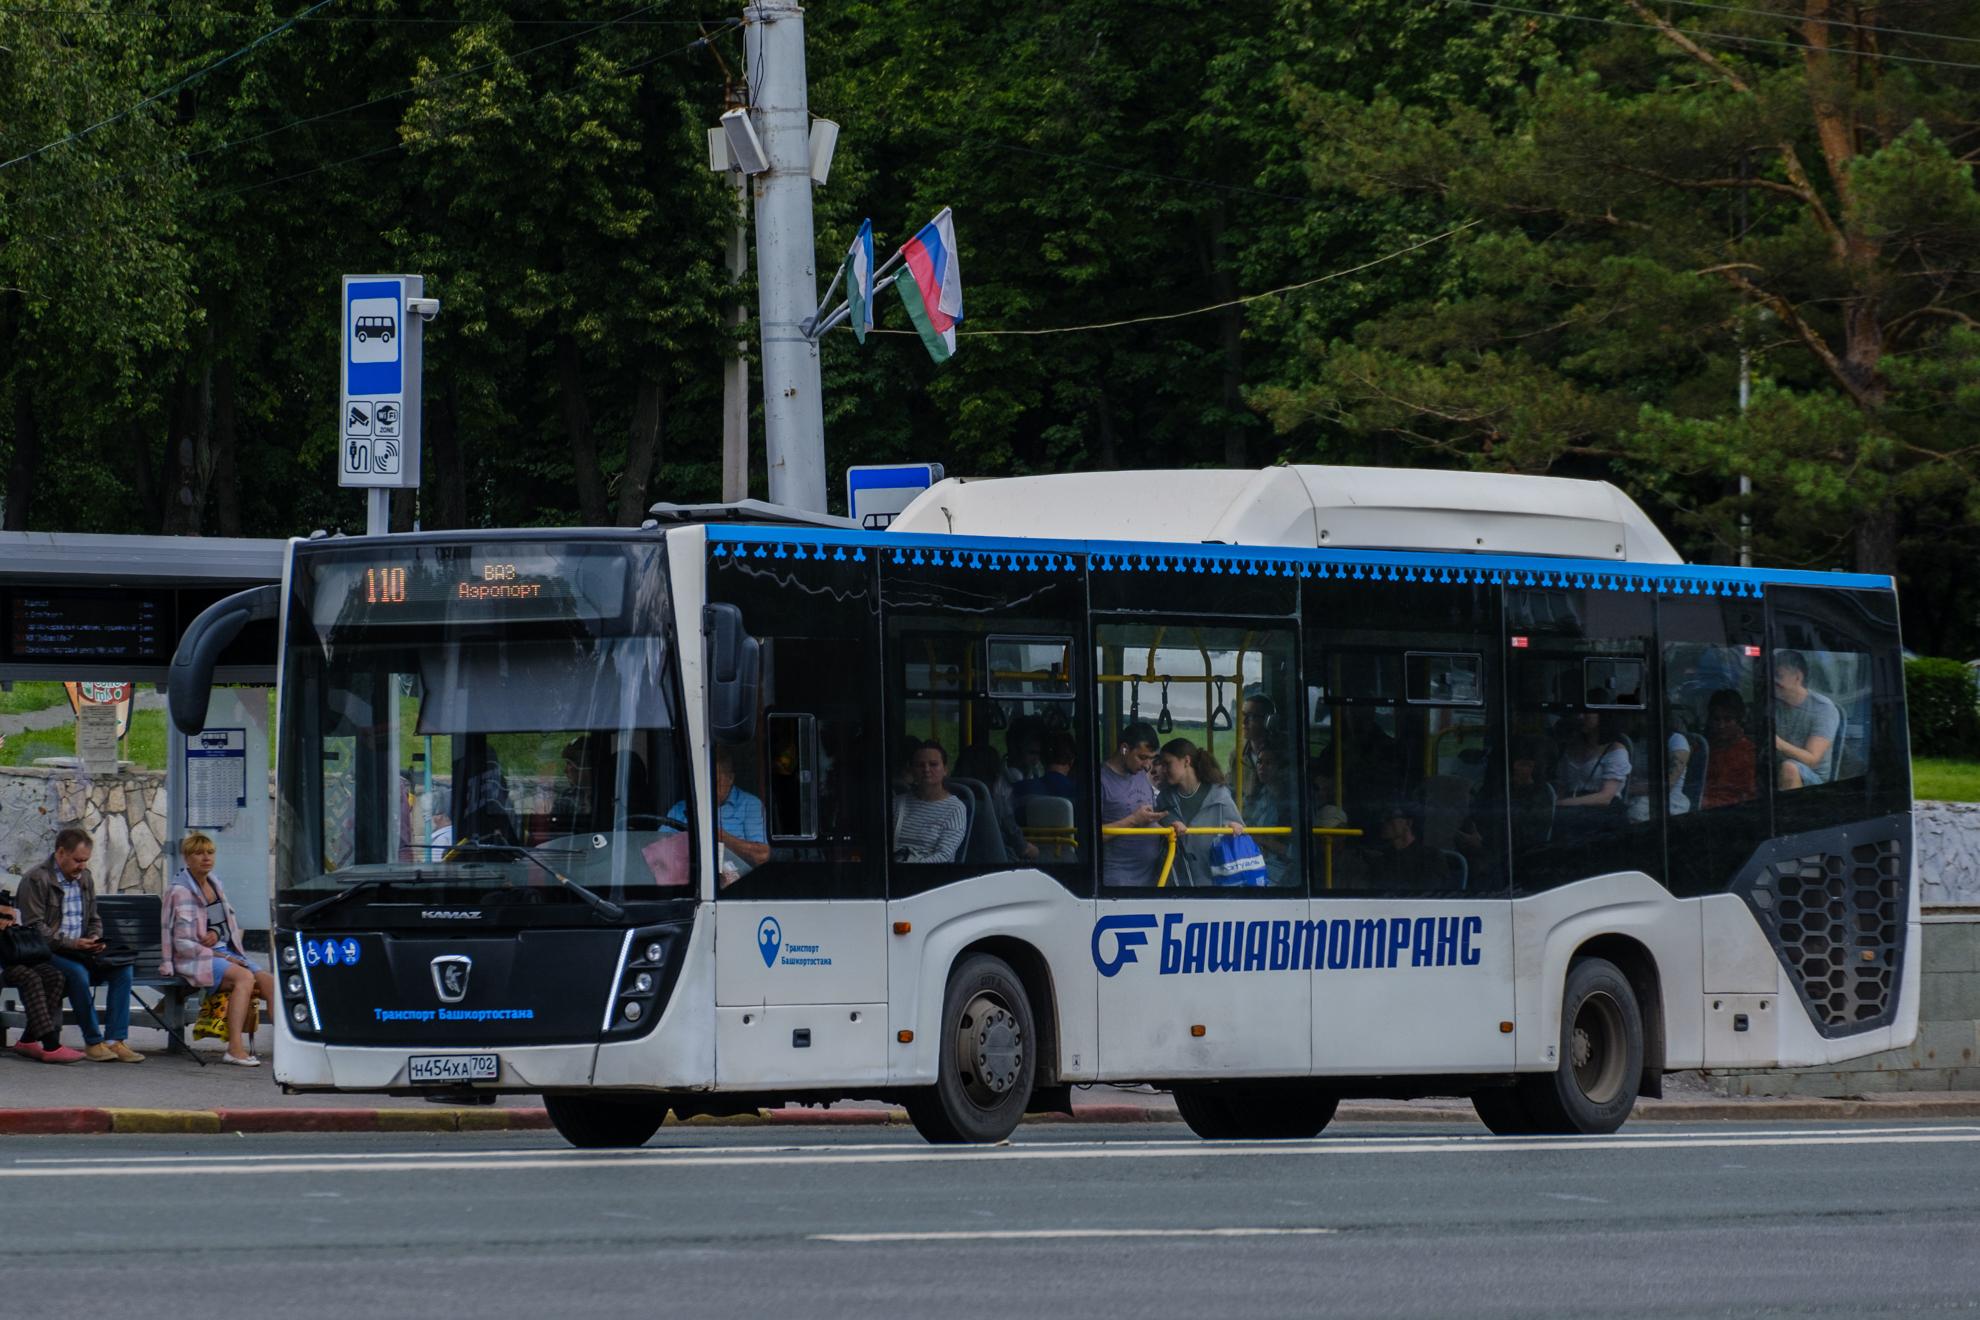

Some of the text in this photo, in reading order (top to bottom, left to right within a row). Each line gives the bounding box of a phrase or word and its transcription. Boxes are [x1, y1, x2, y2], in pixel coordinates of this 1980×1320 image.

[484, 565, 516, 580] ВАЗ
[367, 568, 405, 602] 110
[459, 583, 541, 599] Аэропорт
[421, 911, 482, 919] KAMAZ
[785, 943, 820, 954] Транспорт
[781, 956, 832, 967] Башкортостана
[374, 1008, 534, 1022] Транспорт Башкортостана
[472, 1057, 494, 1070] 702
